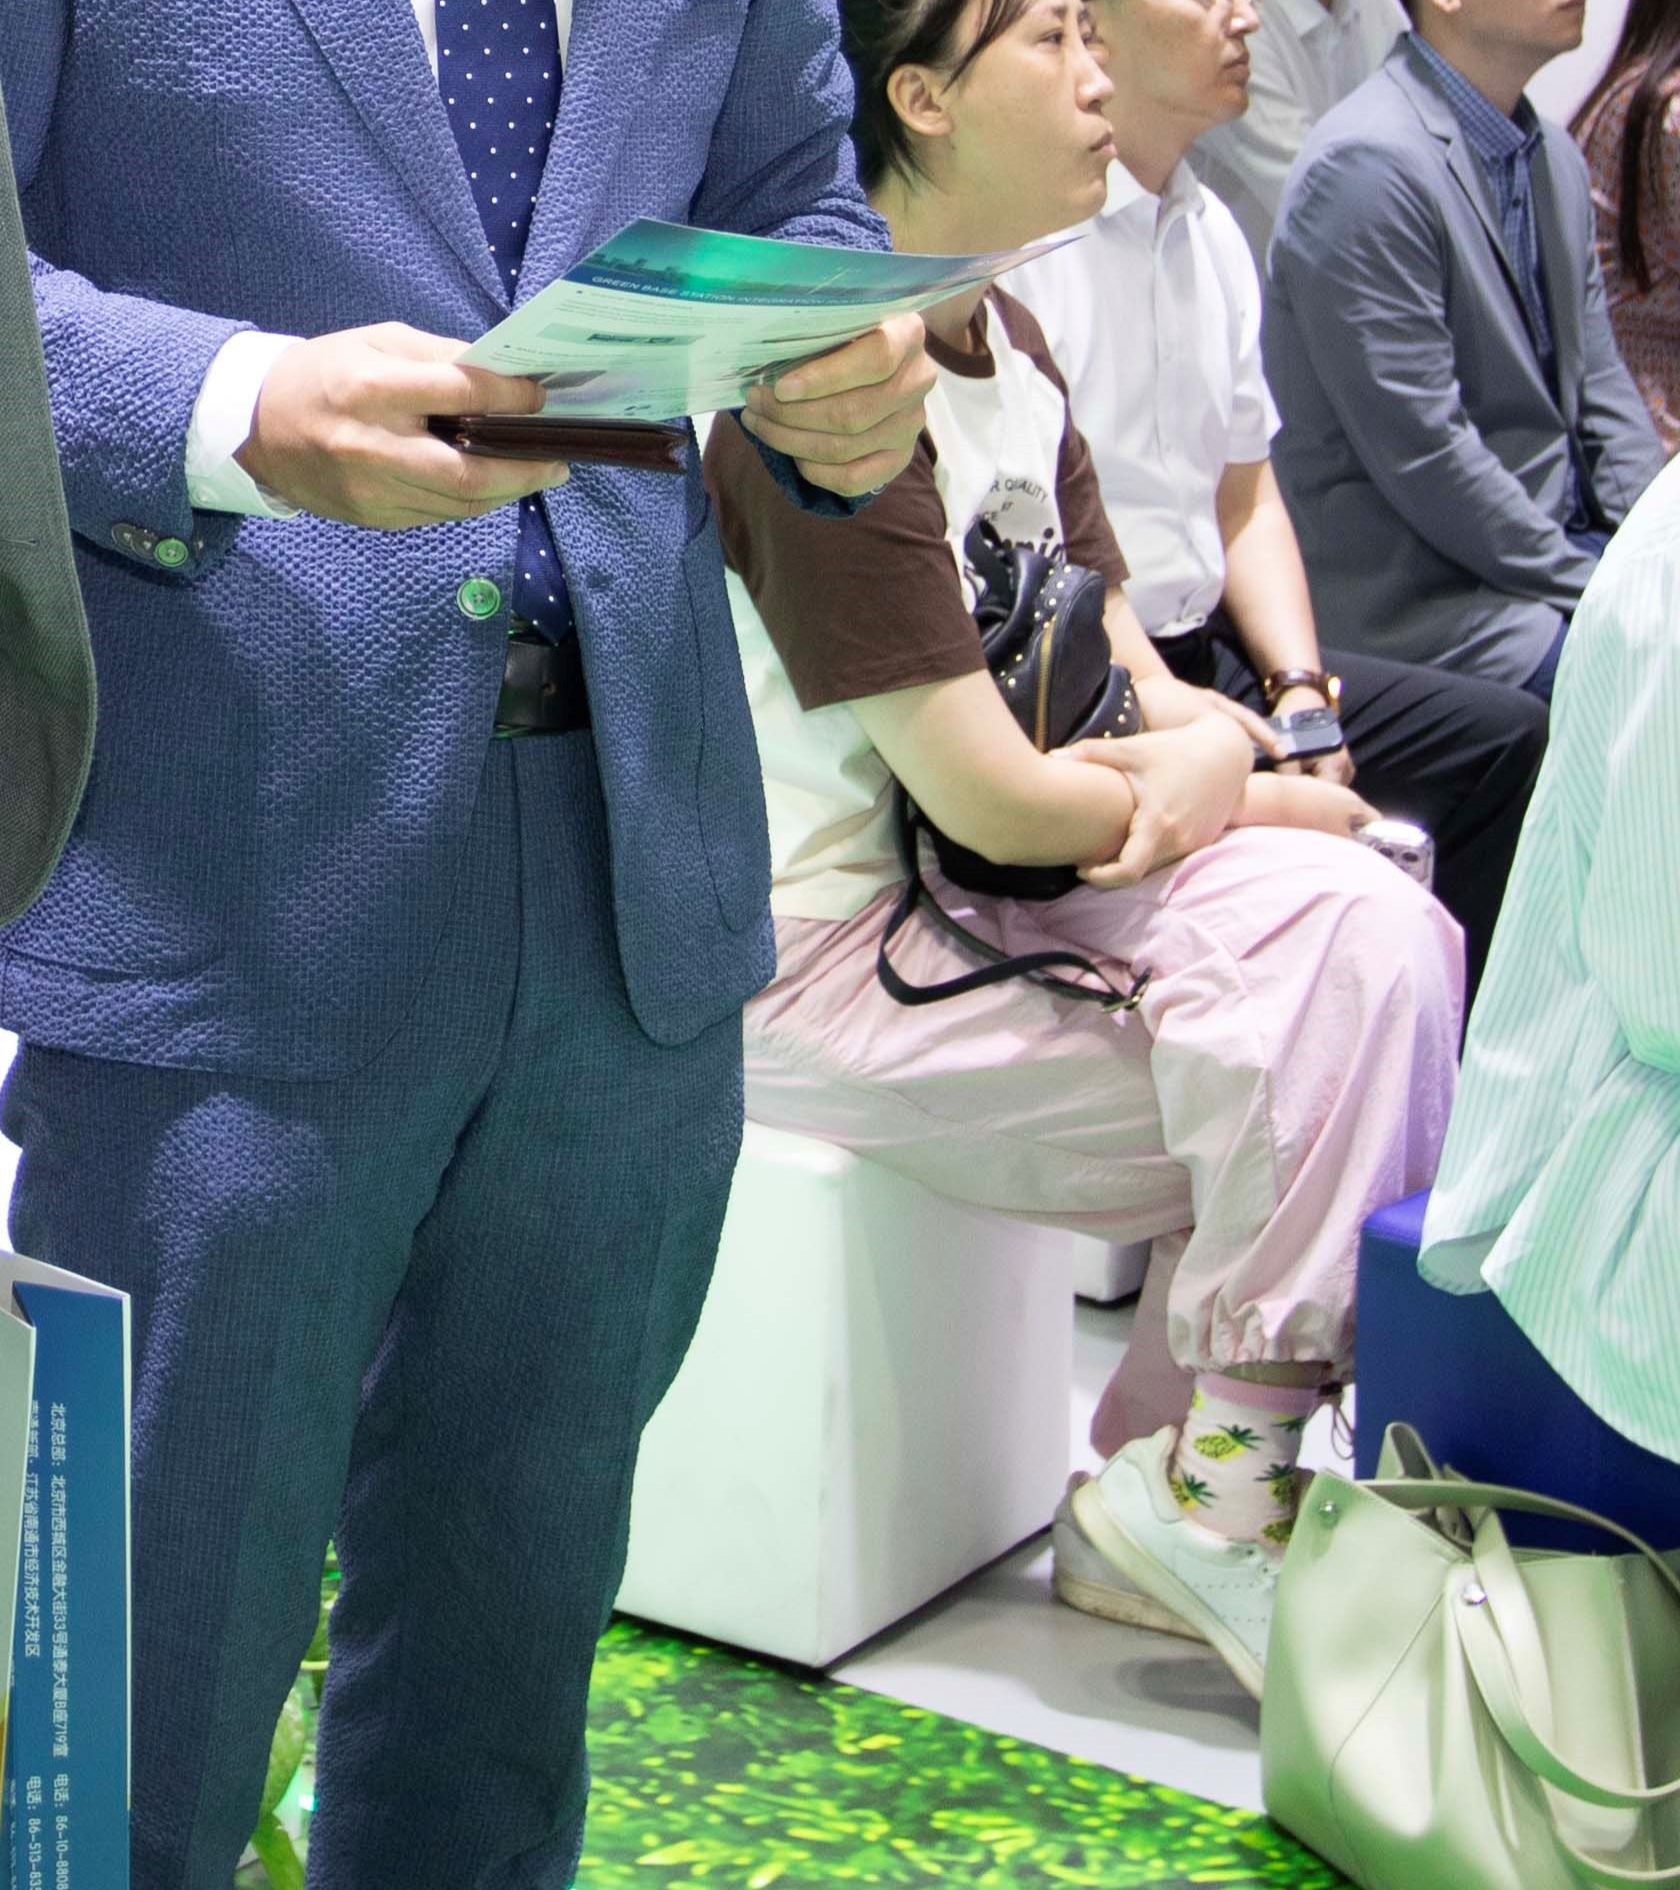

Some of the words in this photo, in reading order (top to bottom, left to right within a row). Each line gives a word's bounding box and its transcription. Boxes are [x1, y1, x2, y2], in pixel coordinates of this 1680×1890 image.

[590, 275, 640, 291] GREEN
[640, 283, 679, 297] BASE
[1004, 477, 1049, 503] QUALITY
